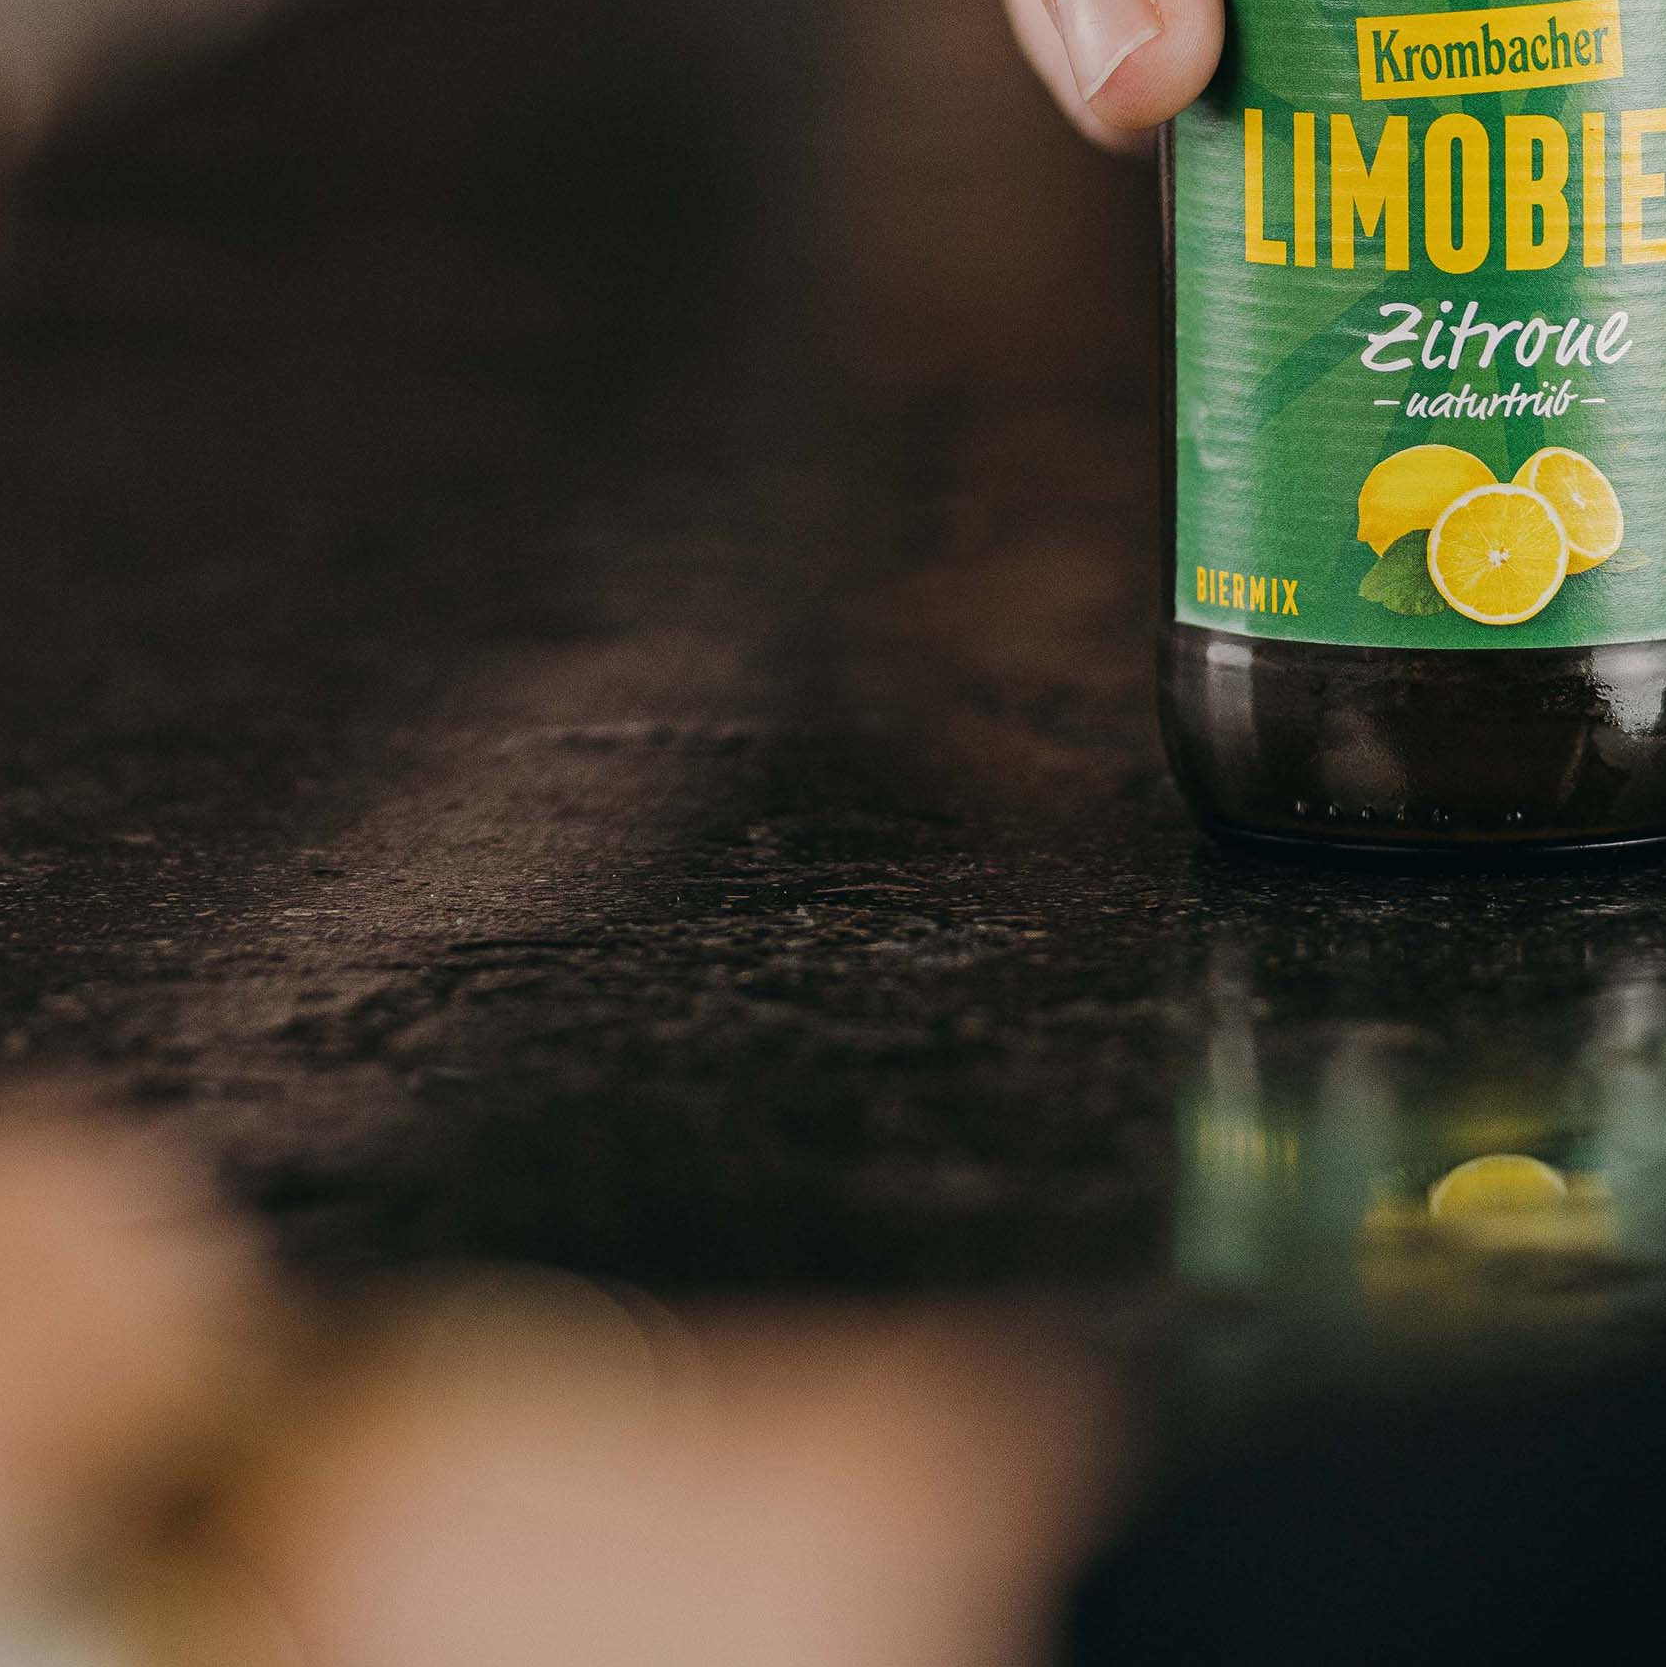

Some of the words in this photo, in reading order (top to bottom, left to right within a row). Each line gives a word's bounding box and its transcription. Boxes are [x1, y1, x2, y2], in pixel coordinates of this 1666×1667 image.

[1373, 16, 1609, 84] Krombacher
[1360, 300, 1634, 373] Zitrone
[1196, 567, 1300, 616] BIERMIX
